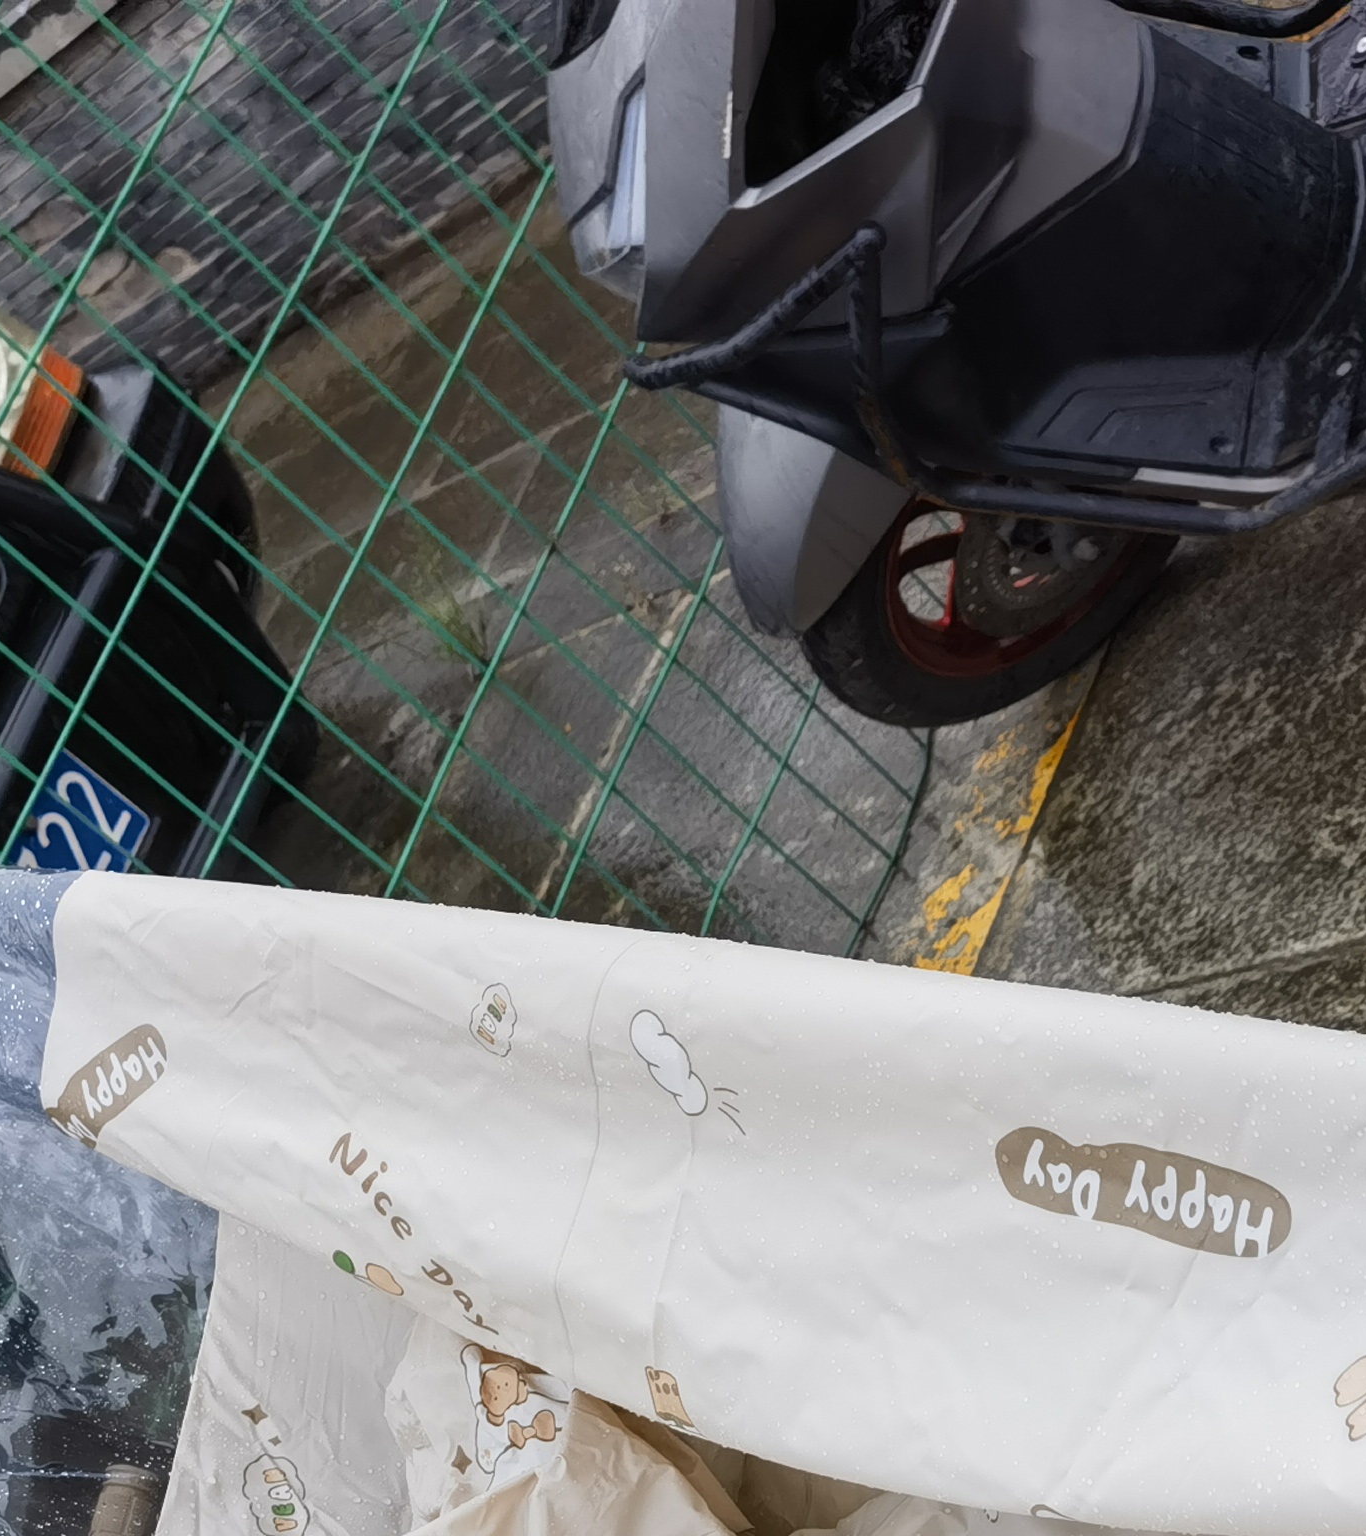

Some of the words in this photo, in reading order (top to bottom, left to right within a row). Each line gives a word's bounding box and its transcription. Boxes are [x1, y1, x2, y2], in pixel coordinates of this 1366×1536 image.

[17, 770, 132, 871] 22
[82, 1037, 167, 1119] Happy
[1023, 1138, 1101, 1221] Day
[1125, 1160, 1274, 1257] Happy
[329, 1132, 412, 1240] Nice
[421, 1259, 500, 1335] Day
